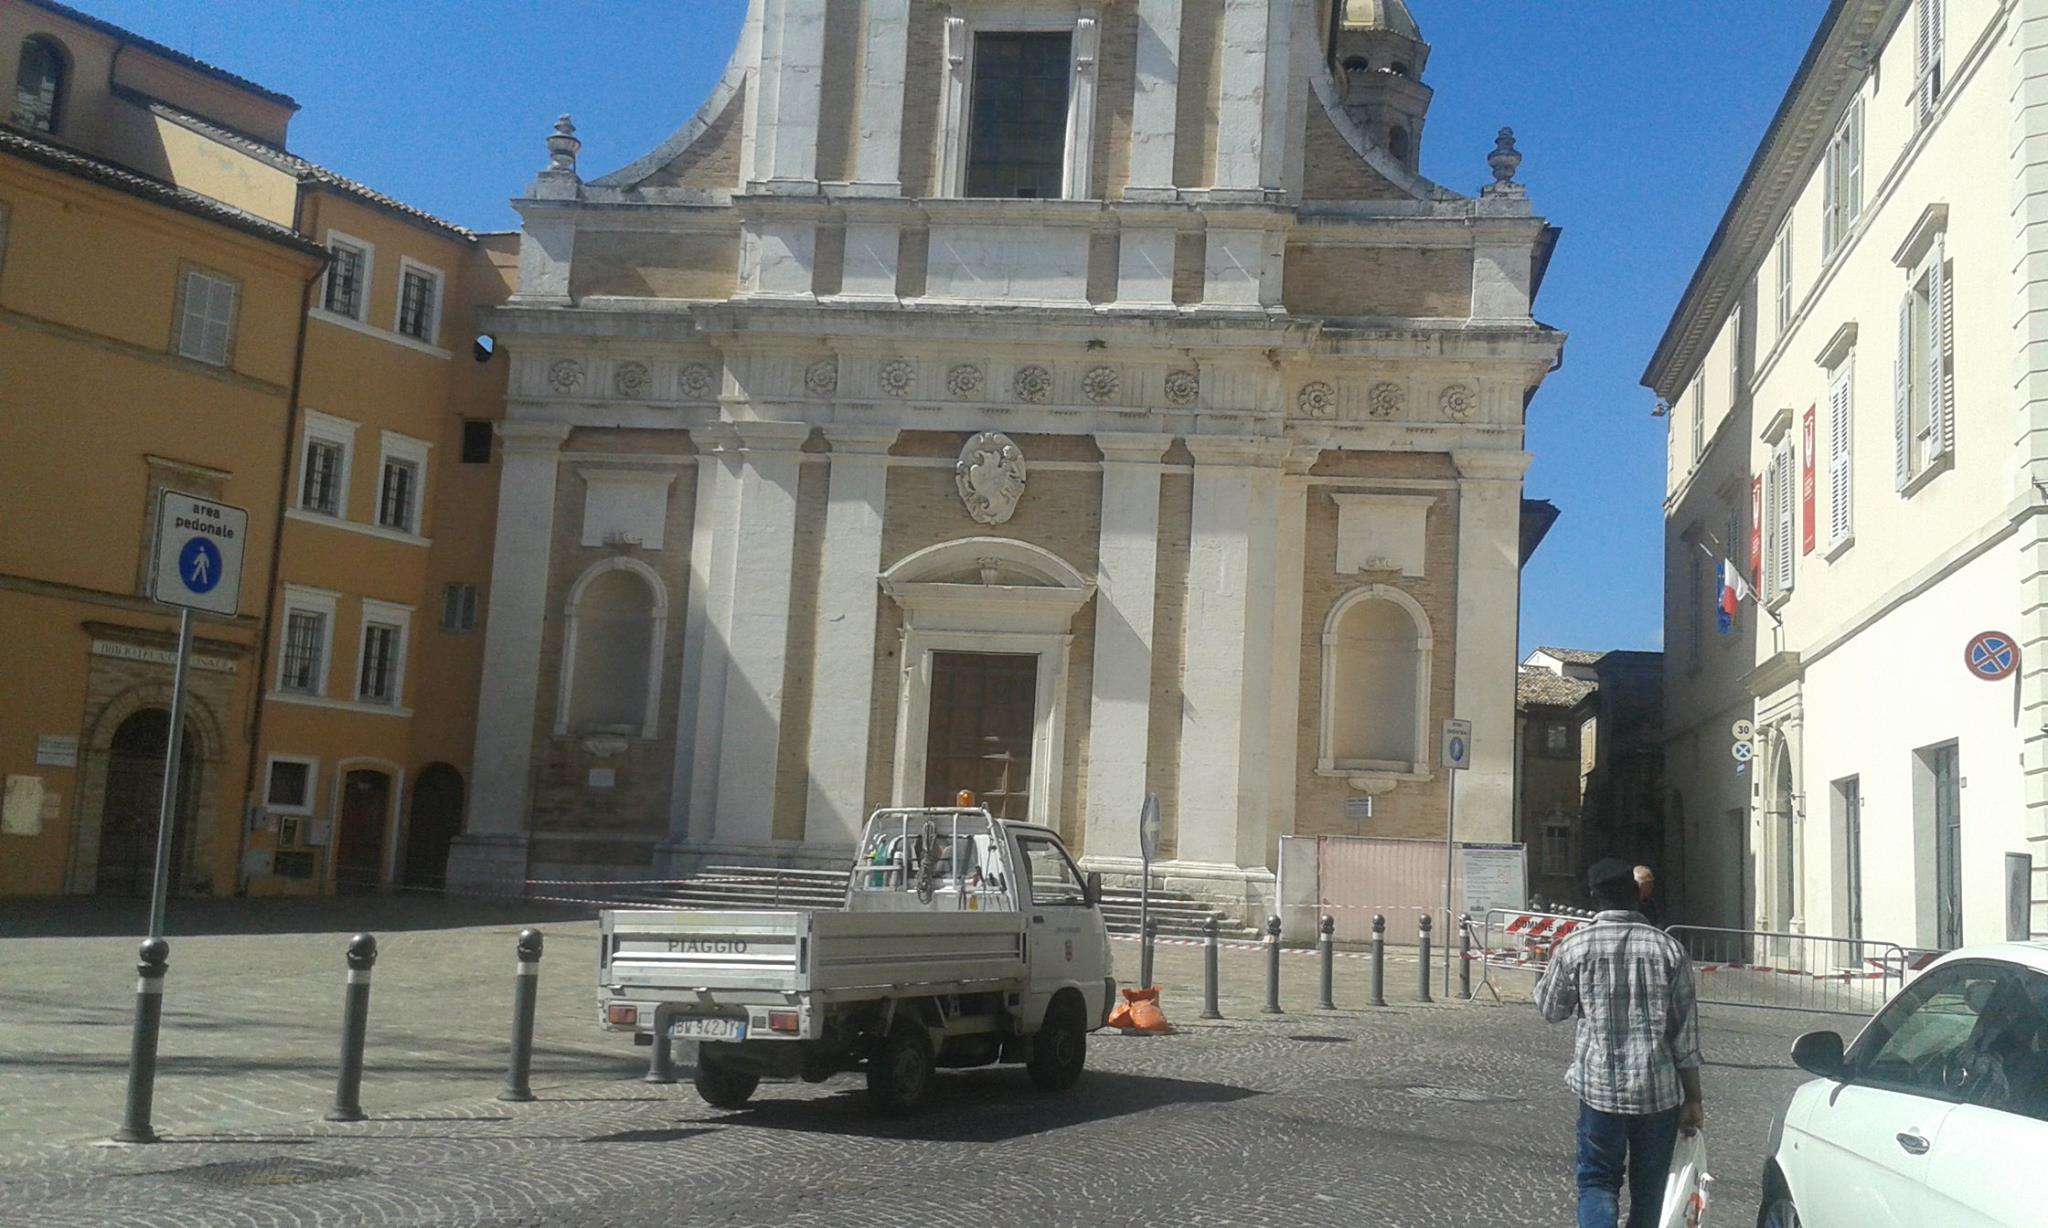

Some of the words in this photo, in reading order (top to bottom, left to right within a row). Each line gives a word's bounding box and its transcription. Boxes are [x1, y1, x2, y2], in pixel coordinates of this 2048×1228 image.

[193, 504, 220, 519] area
[176, 517, 234, 539] pedonale
[1738, 725, 1749, 735] 30
[668, 939, 747, 954] PIAGGIO
